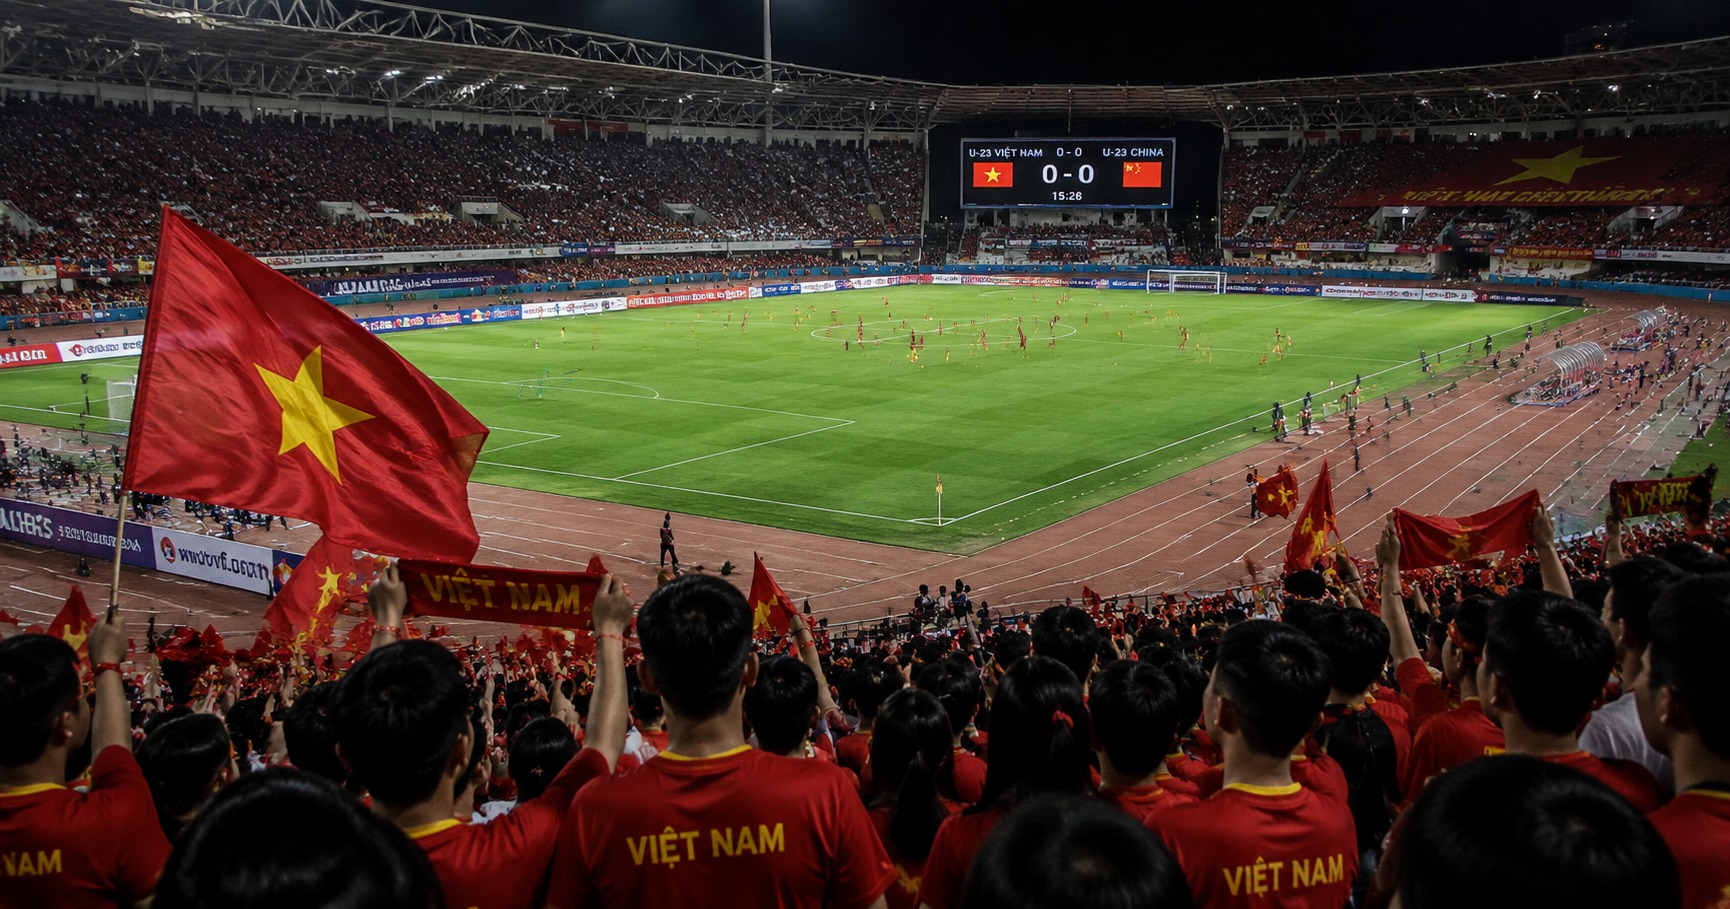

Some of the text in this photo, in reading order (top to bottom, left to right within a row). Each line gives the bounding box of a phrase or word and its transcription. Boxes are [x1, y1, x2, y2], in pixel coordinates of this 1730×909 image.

[968, 148, 992, 158] U-23
[1019, 148, 1043, 157] NAM
[1056, 147, 1064, 157] 0
[1074, 147, 1083, 157] 0
[1102, 147, 1164, 157] U-23 CHINA
[1042, 164, 1058, 184] 0
[1078, 164, 1094, 184] 0
[1052, 191, 1083, 201] 15:26
[421, 567, 580, 615] VIỆT NAM
[626, 822, 786, 869] VIỆT NAM
[0, 849, 63, 876] NAM
[1223, 854, 1344, 898] VIỆT NAM
